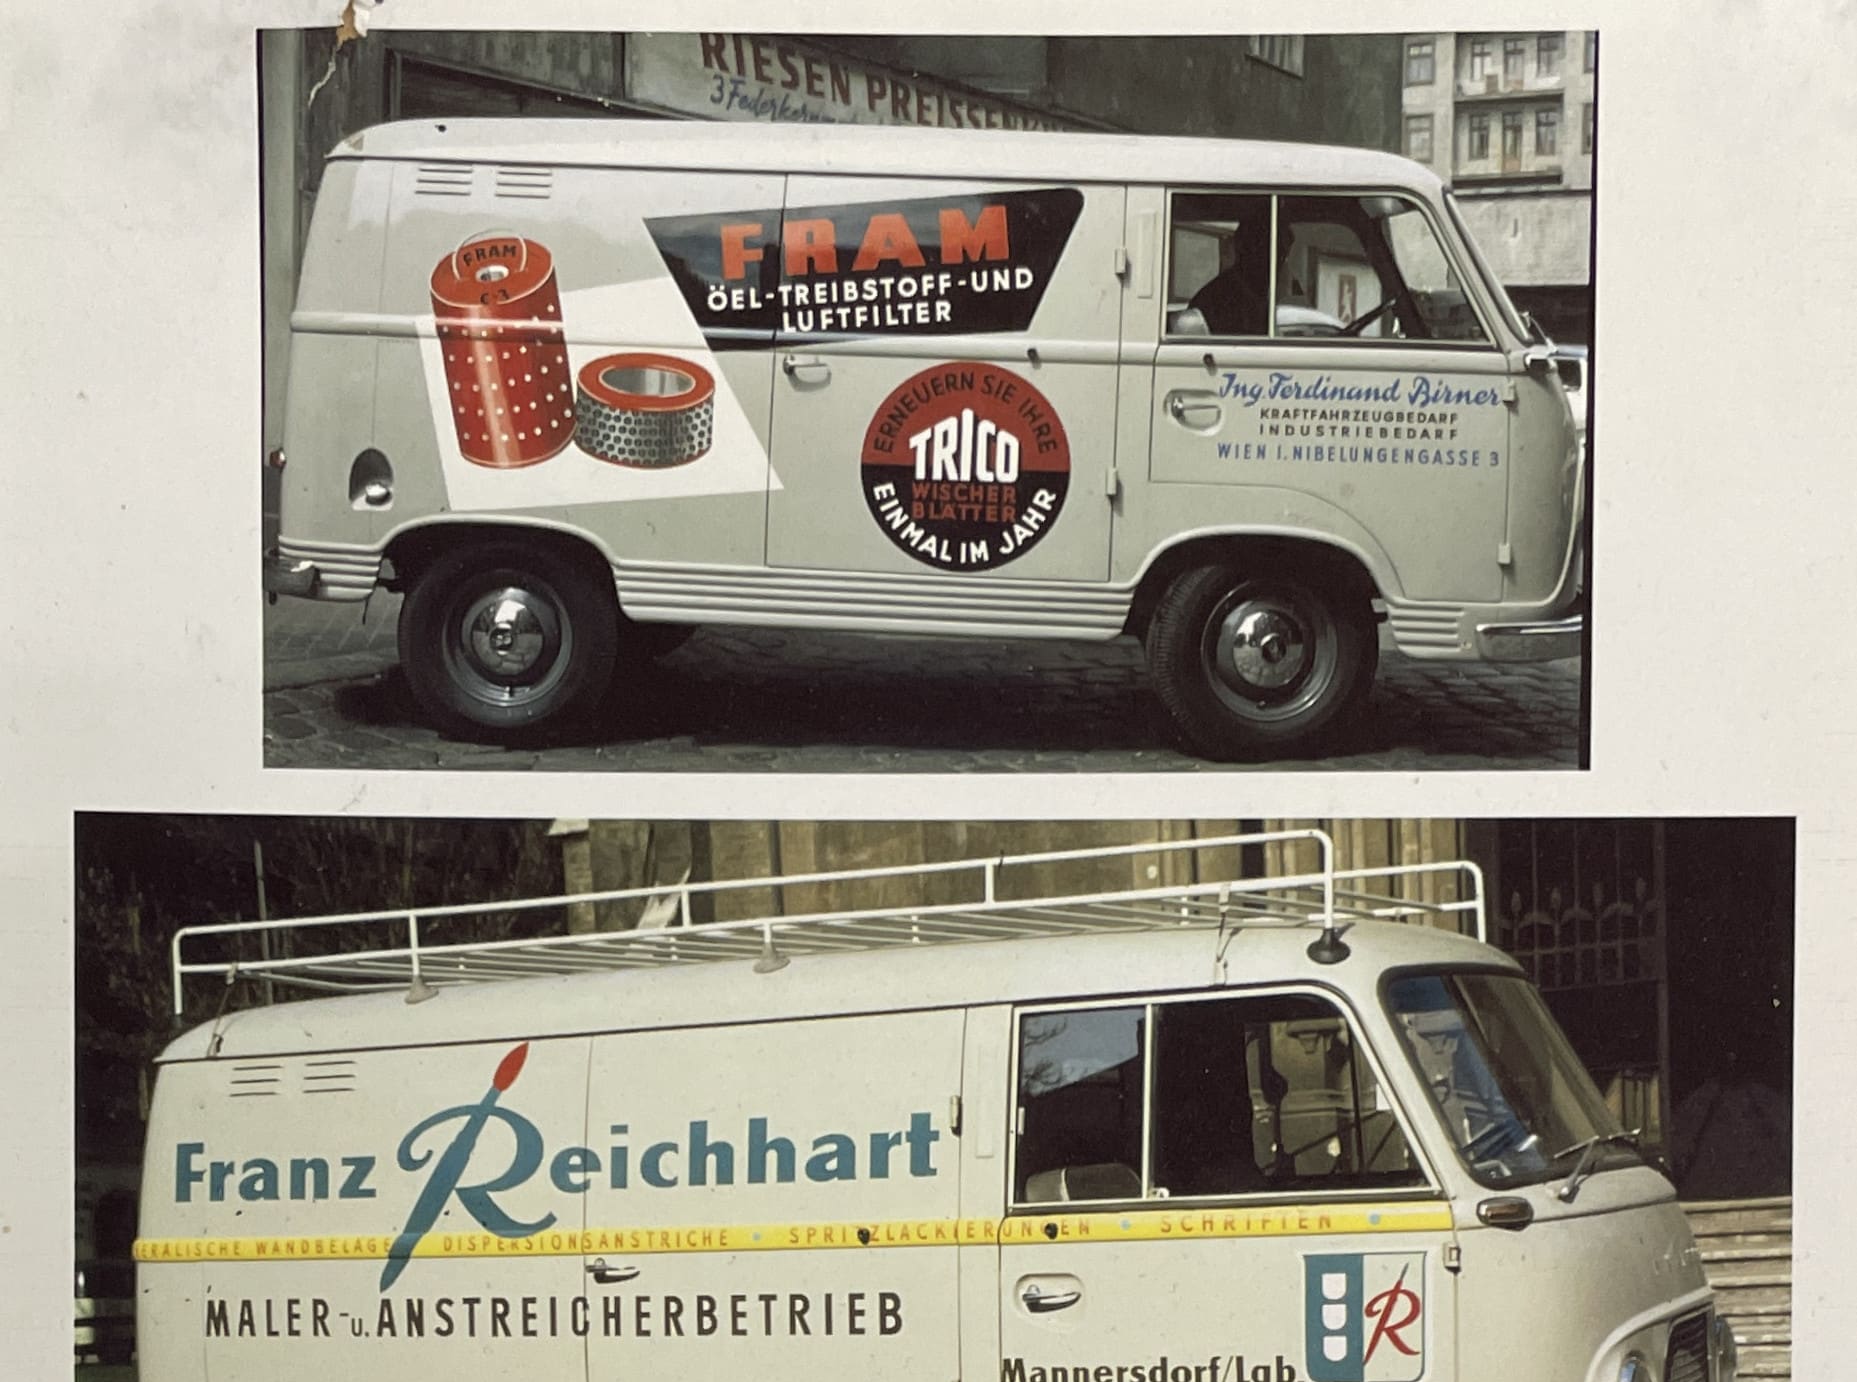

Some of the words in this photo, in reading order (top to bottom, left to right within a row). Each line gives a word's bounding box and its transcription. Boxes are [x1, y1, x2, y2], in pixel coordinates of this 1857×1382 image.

[701, 31, 852, 107] RIESEN
[709, 73, 725, 105] 3
[463, 244, 516, 267] FRAM
[720, 205, 1010, 281] FRAM
[782, 300, 952, 333] LUFTFILTER
[1268, 372, 1401, 401] Ferdinand
[1408, 375, 1500, 408] Birner
[874, 371, 975, 454] ERNEUERN
[981, 374, 1017, 405] SIE
[1018, 397, 1058, 454] IHRE
[1260, 408, 1459, 425] KRAFTFAHRZEUGBEDARF
[909, 407, 1020, 484] TRICO
[1259, 423, 1459, 441] INDUSTRIEBEDARF
[1217, 442, 1267, 460] WIEN
[1490, 450, 1500, 467] 3
[911, 482, 1017, 504] WISCHER
[873, 482, 953, 563] EINMAL
[959, 540, 990, 565] IM
[999, 488, 1057, 556] JAHR
[175, 1142, 378, 1203] Franz
[381, 1043, 940, 1293] Reichhart
[443, 1231, 730, 1252] DISPERSIONSANSTRICHE
[788, 1220, 1091, 1246] SPRIZLACKIERUNEN
[1159, 1213, 1332, 1234] SCHRIFTEN
